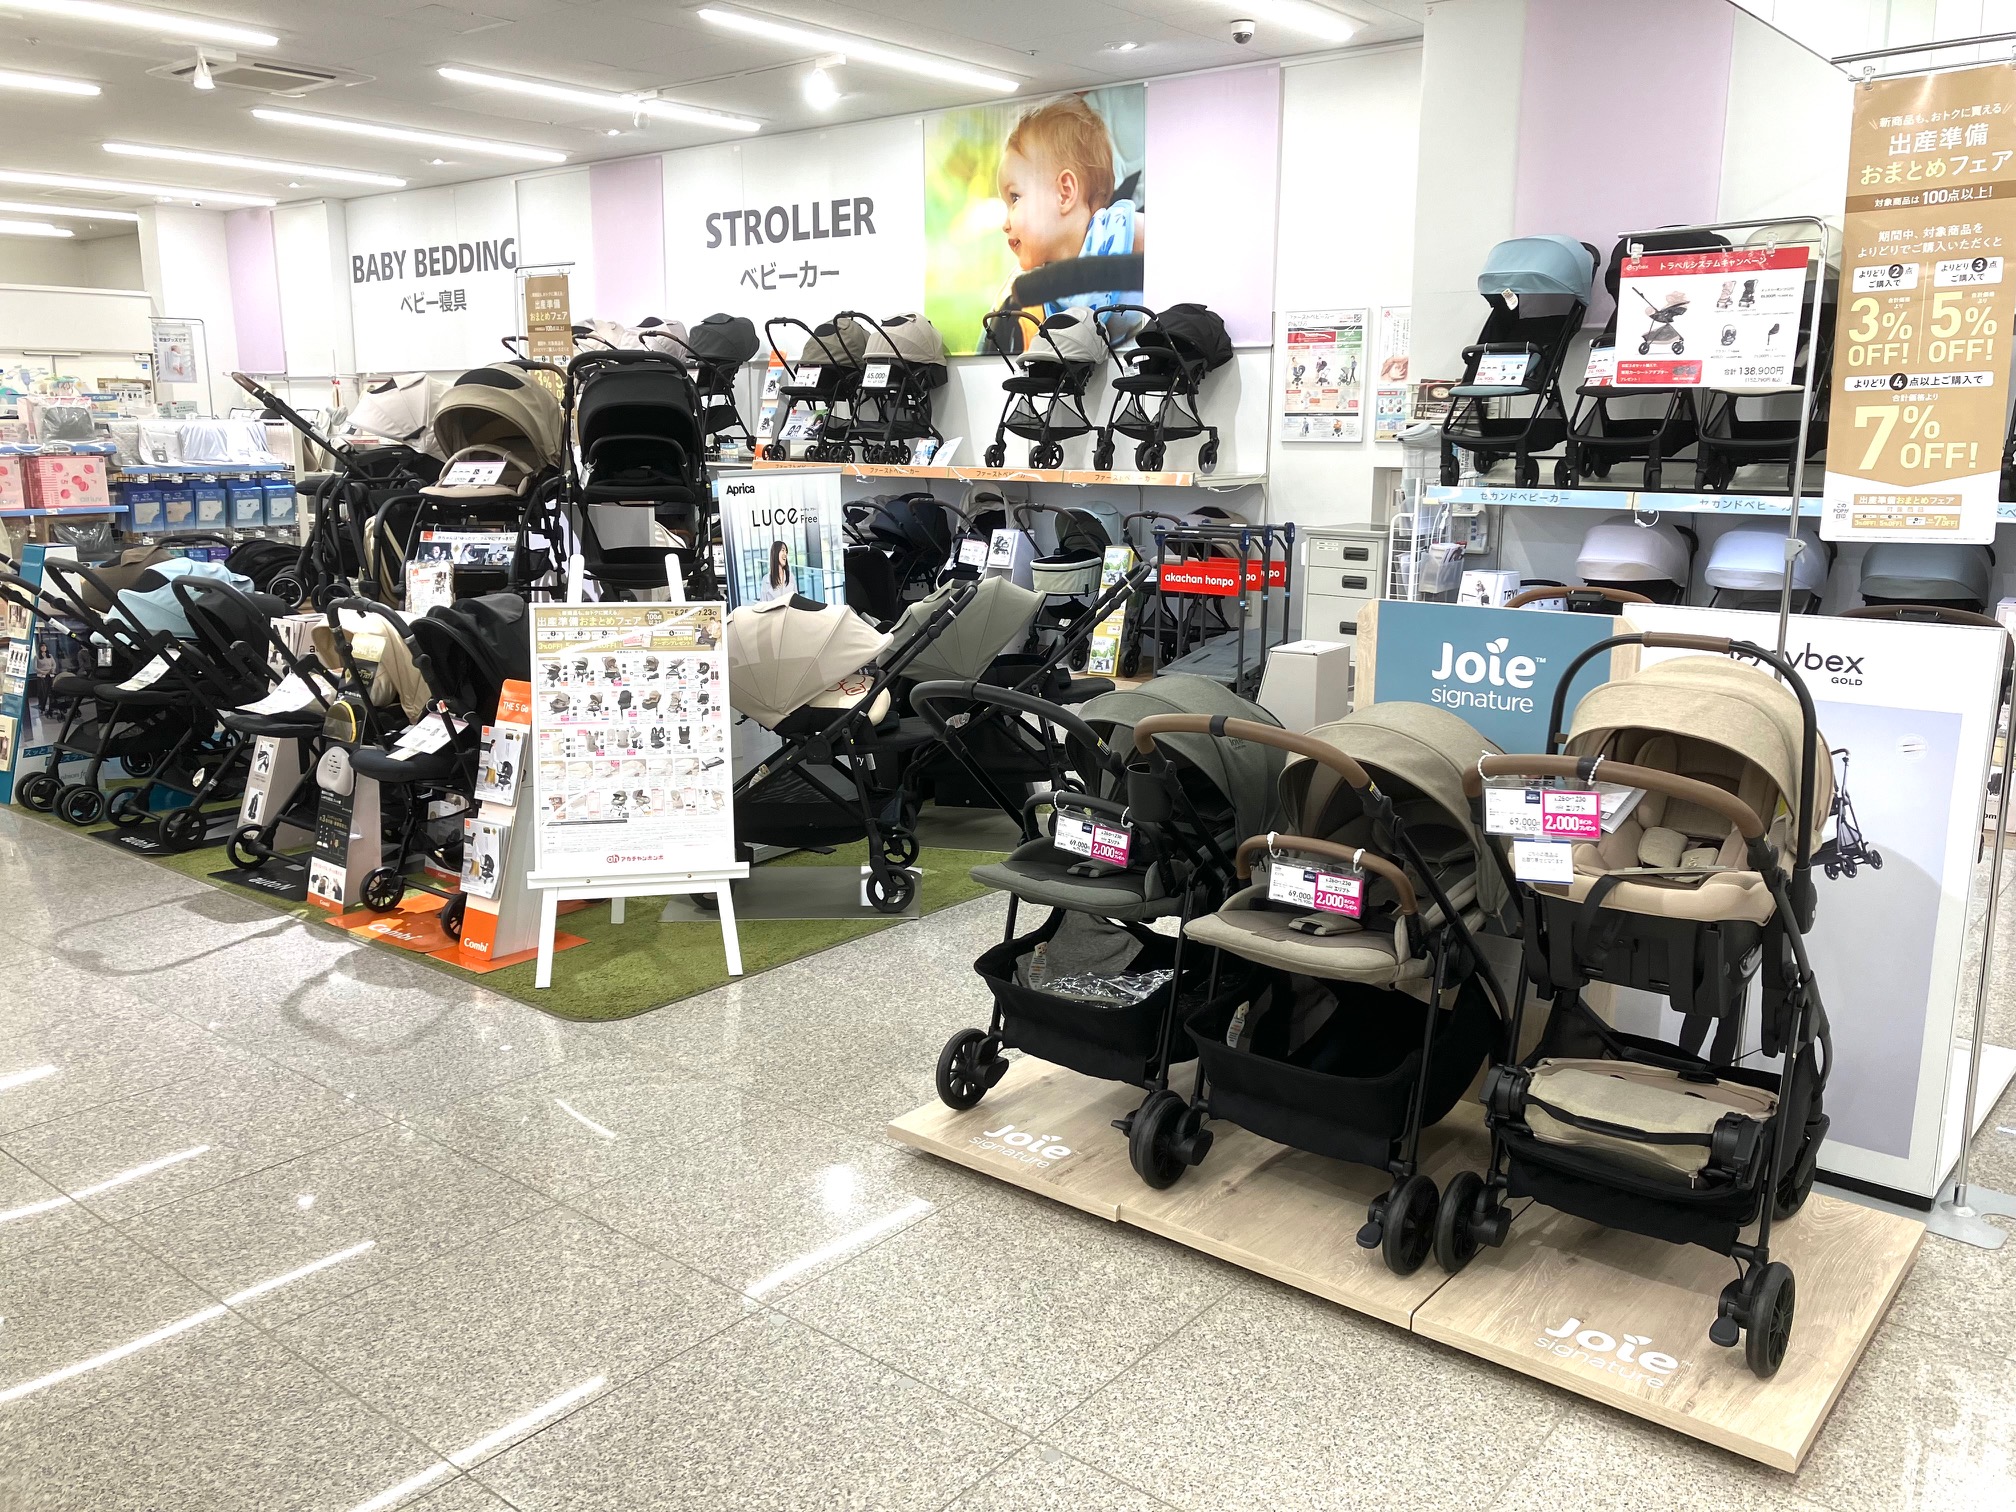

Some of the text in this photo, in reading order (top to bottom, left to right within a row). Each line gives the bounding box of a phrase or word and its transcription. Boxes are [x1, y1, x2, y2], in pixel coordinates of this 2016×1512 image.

[1879, 103, 2001, 128] 新商品も、おトクに買える
[1888, 123, 1989, 156] 出産準備
[1860, 149, 2014, 185] おまとめフェア
[706, 196, 876, 249] STROLLER
[1878, 223, 1983, 243] 期間中、対象商品を
[1857, 236, 2002, 258] よりどりでご購入いただくと
[352, 238, 517, 284] BABY BEDDING
[739, 261, 840, 292] ベビーカー
[1868, 279, 1901, 288] ご購入で
[1950, 273, 1985, 283] ご購入で
[400, 288, 468, 315] ベビー寝具
[534, 299, 561, 309] 出産準備
[530, 311, 568, 322] おまとめフェア
[1848, 297, 1913, 343] 3%
[1930, 291, 1998, 338] 5%
[1848, 342, 1910, 367] OFF!
[1928, 338, 1994, 363] OFF!
[1738, 366, 1784, 376] 138,900円
[1900, 442, 1979, 469] OFF!
[726, 482, 755, 496] Aprica
[1480, 492, 1569, 503] セカンドベビーカー
[1859, 495, 1955, 505] 出産準備おまとめフェア
[800, 514, 818, 524] Free
[1164, 571, 1234, 588] akachan honpo
[537, 616, 642, 627] 出産準備おまとめフェア
[1431, 638, 1537, 690] Joie
[1831, 676, 1863, 686] GOLD
[502, 701, 514, 711] THE
[521, 704, 529, 713] Go
[1430, 684, 1533, 713] signature
[1545, 815, 1579, 831] 2,000
[621, 854, 664, 862] アカチャンホンポ
[1093, 843, 1115, 858] 2,000
[1316, 891, 1344, 908] 2,000
[367, 923, 423, 941] Combi
[464, 937, 489, 953] Combi
[968, 1135, 1051, 1169] signature
[983, 1124, 1072, 1160] Joie
[1544, 1317, 1679, 1375] Joie
[1533, 1336, 1665, 1389] signature
